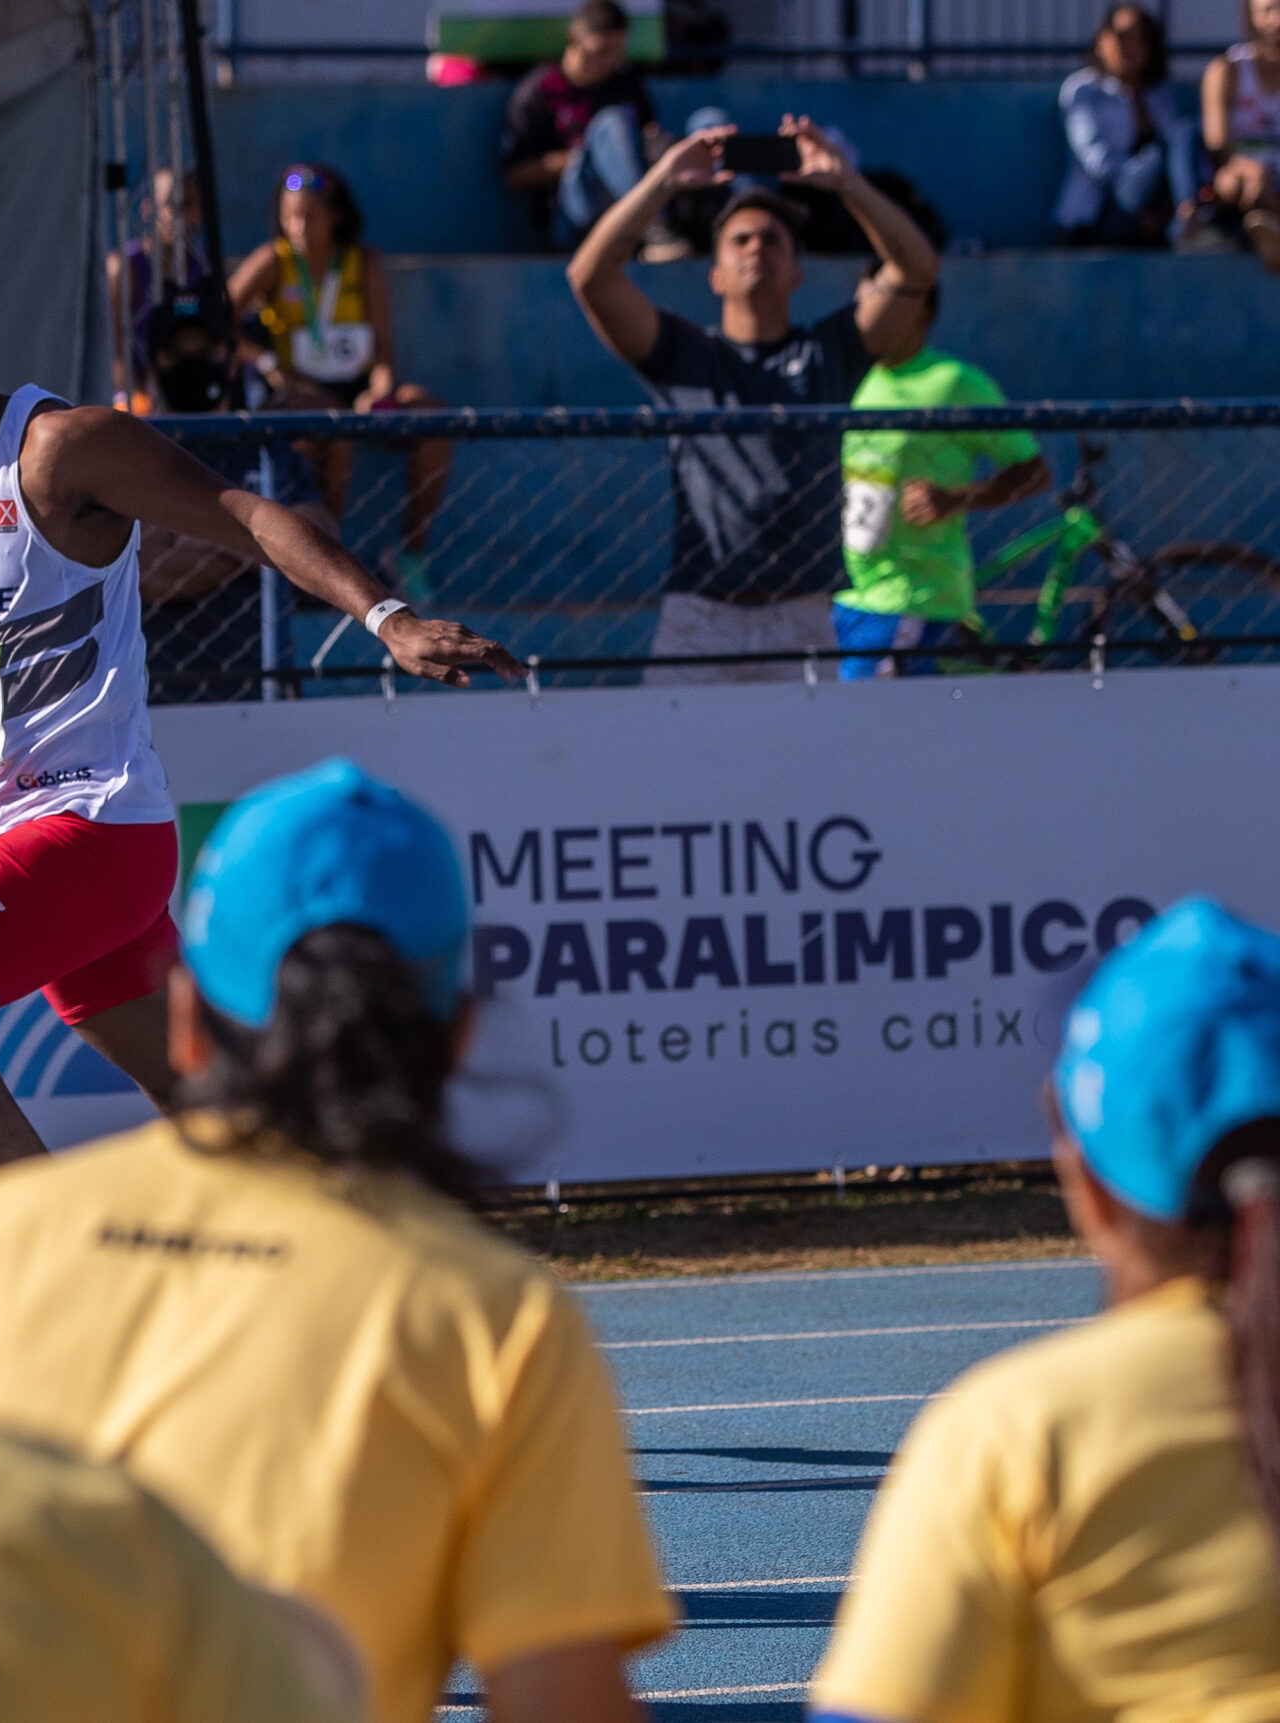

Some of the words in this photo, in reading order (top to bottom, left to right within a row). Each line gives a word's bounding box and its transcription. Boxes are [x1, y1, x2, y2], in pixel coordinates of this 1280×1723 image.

[471, 815, 882, 905] MEETING
[550, 1008, 839, 1068] loterias
[881, 997, 1042, 1052] caix
